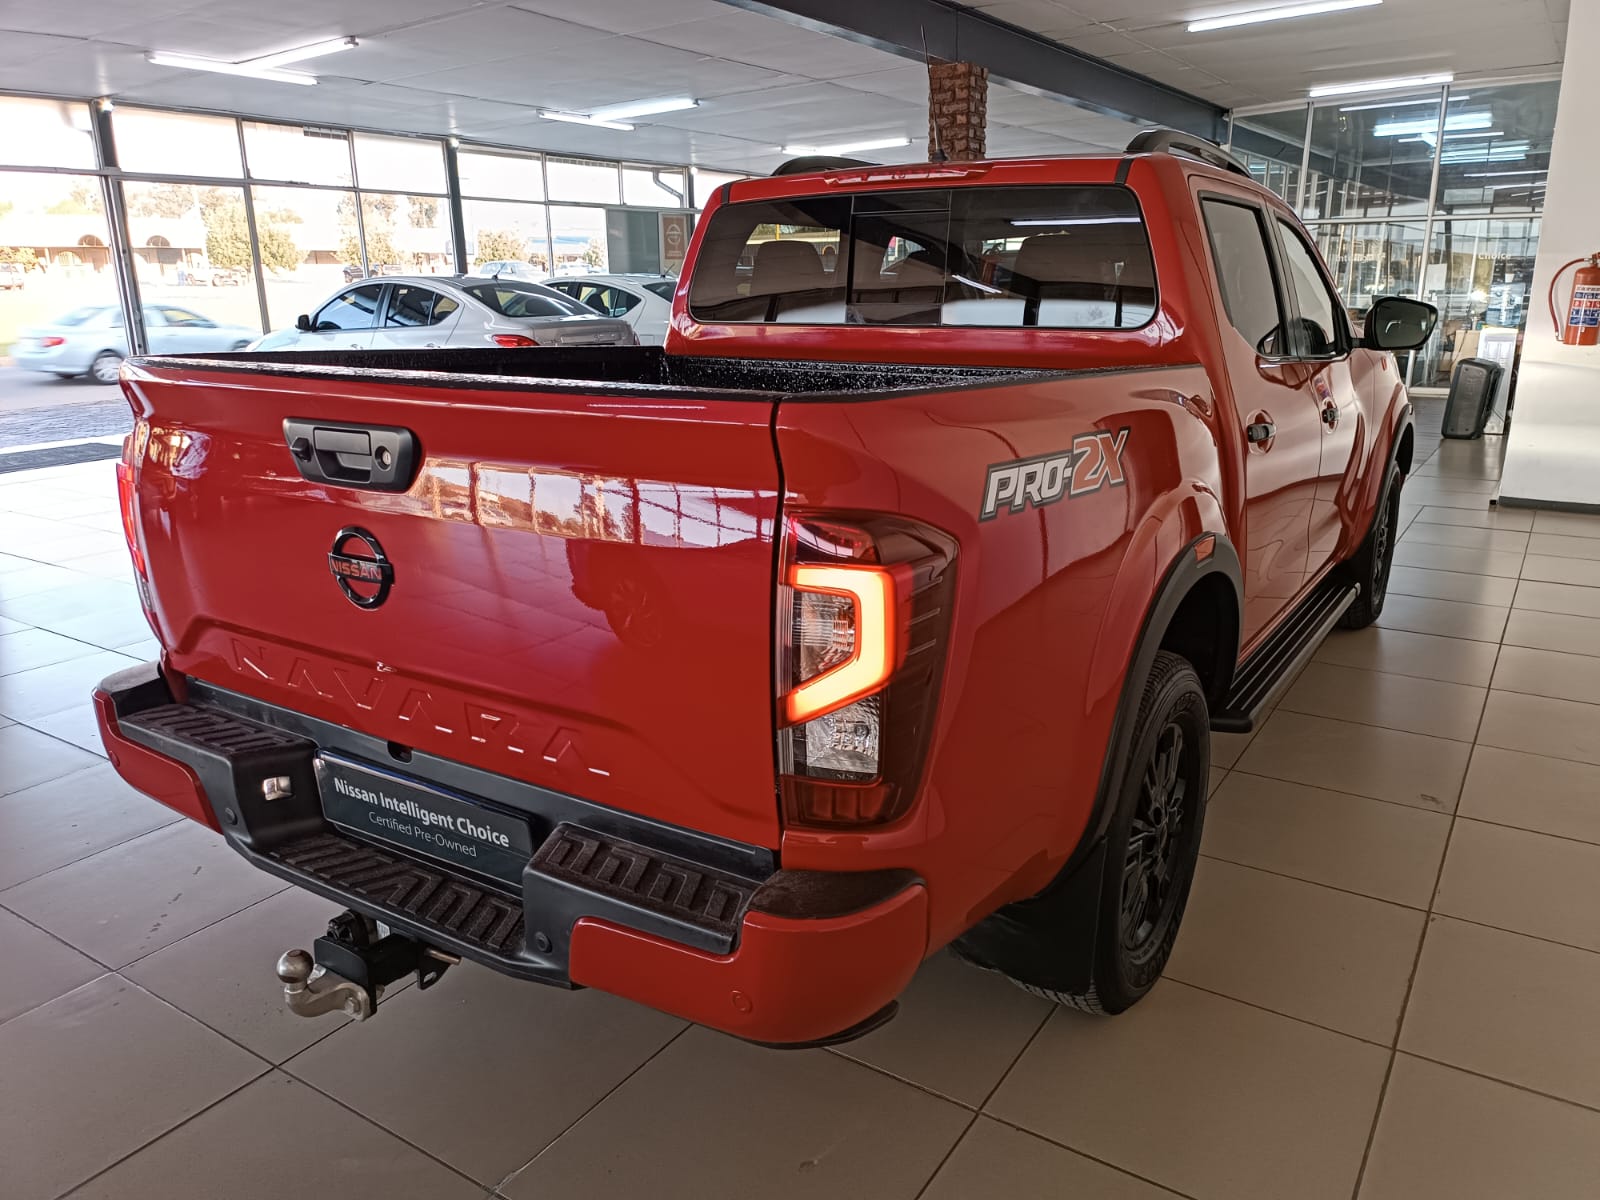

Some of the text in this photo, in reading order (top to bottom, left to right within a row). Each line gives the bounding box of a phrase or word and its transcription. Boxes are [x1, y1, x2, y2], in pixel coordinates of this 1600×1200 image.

[981, 428, 1131, 517] PRO-2X
[331, 558, 382, 580] NISSAN
[231, 637, 611, 776] NAVARA
[334, 777, 510, 848] Nissan Intelligent Choice
[368, 811, 477, 857] Certified Pre-Owned
